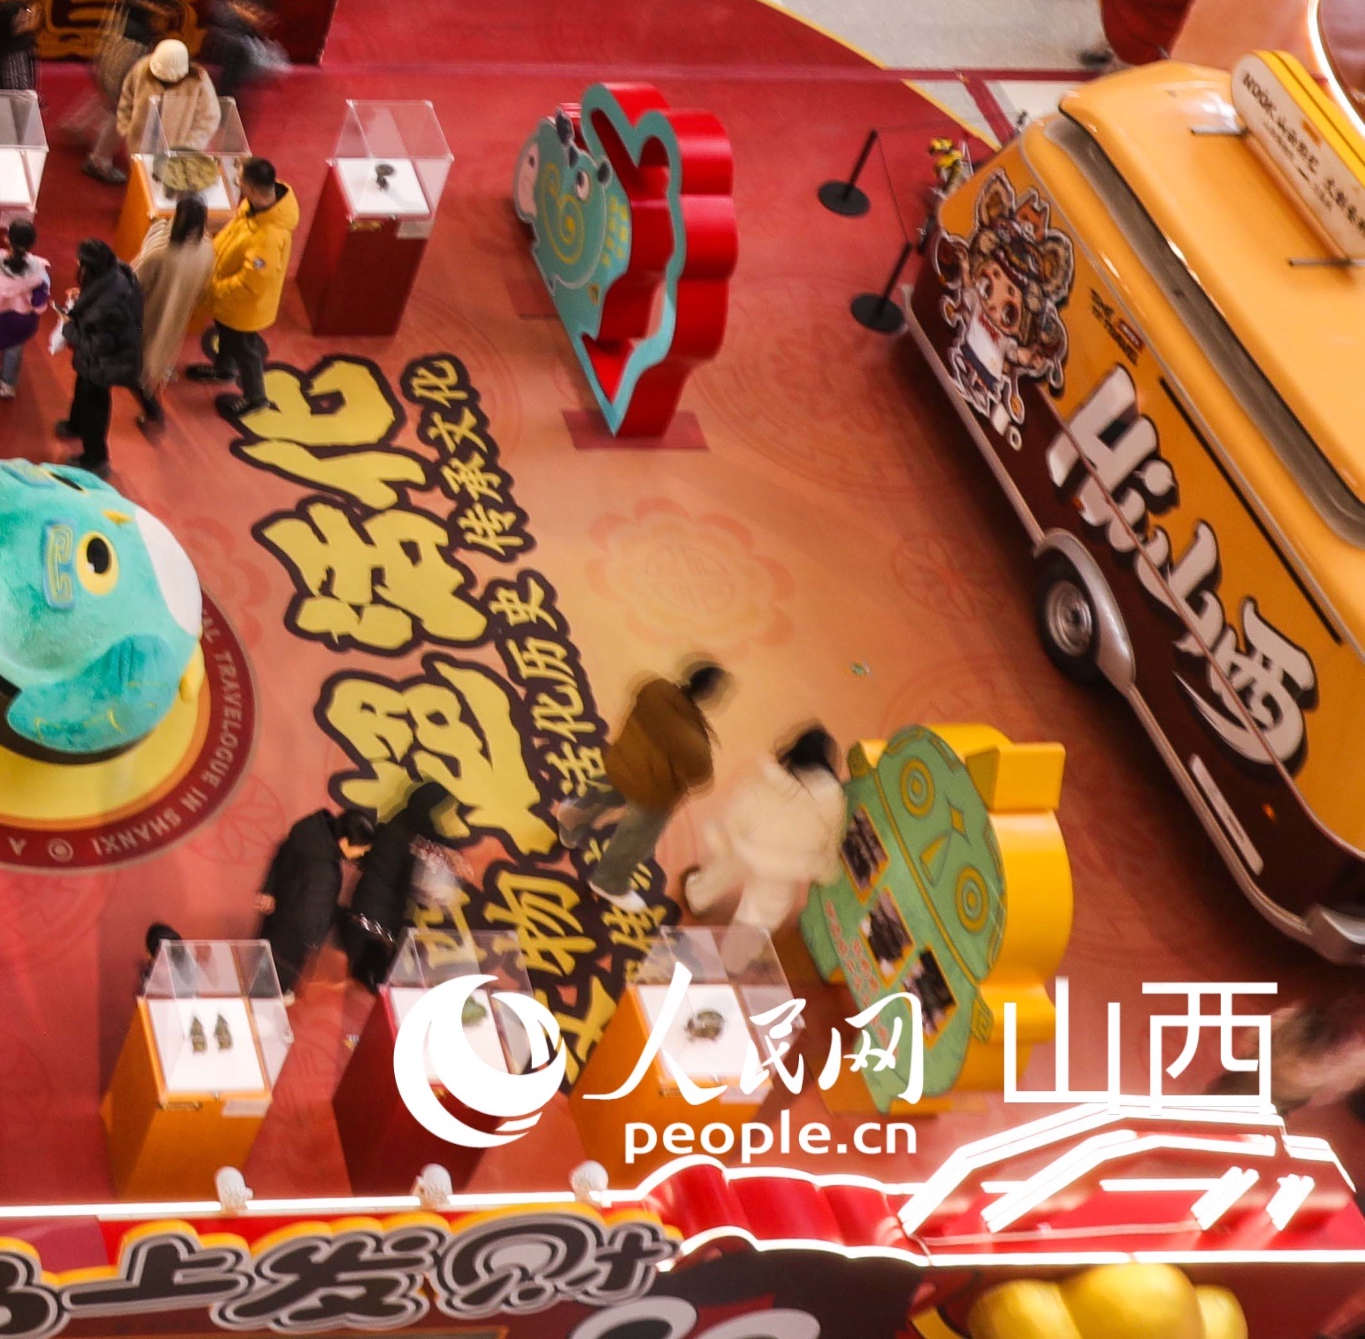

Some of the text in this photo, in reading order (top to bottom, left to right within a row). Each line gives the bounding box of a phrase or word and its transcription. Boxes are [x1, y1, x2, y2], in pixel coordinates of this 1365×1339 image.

[408, 359, 516, 556] 传承文化
[202, 650, 244, 802] TRAVELOGUE
[490, 577, 612, 797] 活化历史
[91, 815, 183, 856] SHANXI
[187, 794, 209, 816] IN
